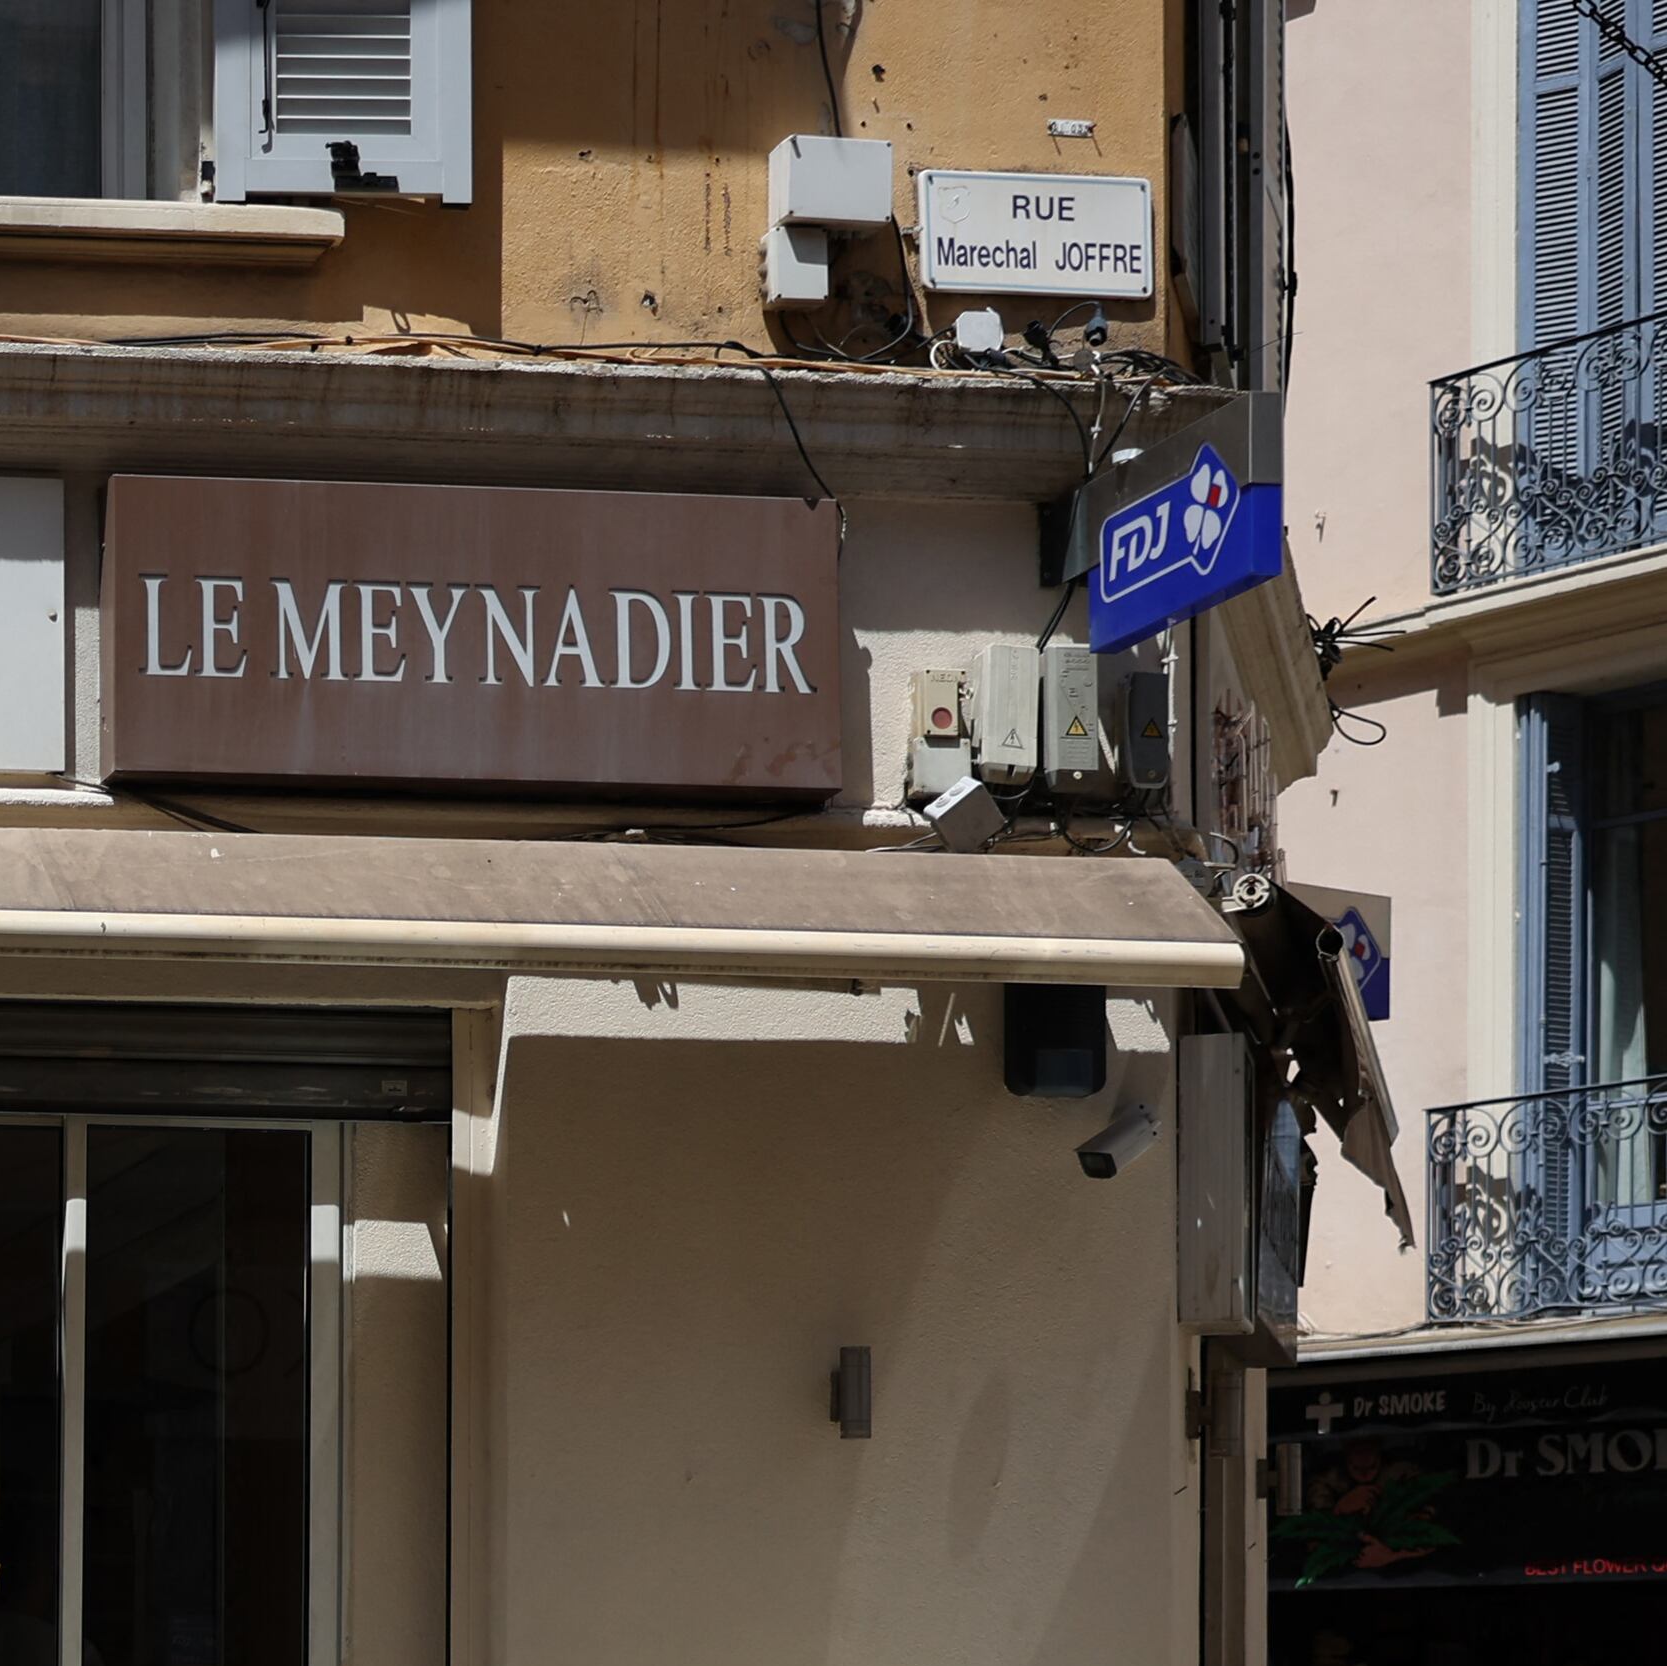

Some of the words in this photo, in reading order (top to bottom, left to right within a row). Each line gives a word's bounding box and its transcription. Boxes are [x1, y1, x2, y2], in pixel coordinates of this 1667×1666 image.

[1011, 194, 1076, 223] RUE
[936, 236, 1038, 271] Marechal
[1055, 242, 1143, 275] JOFFRE
[1107, 500, 1170, 582] FDJ
[139, 574, 247, 679] LE
[269, 577, 817, 694] MEYNADIER
[1353, 1396, 1374, 1419] Dr
[1378, 1389, 1447, 1416] SMOKE
[1464, 1438, 1524, 1480] Dr
